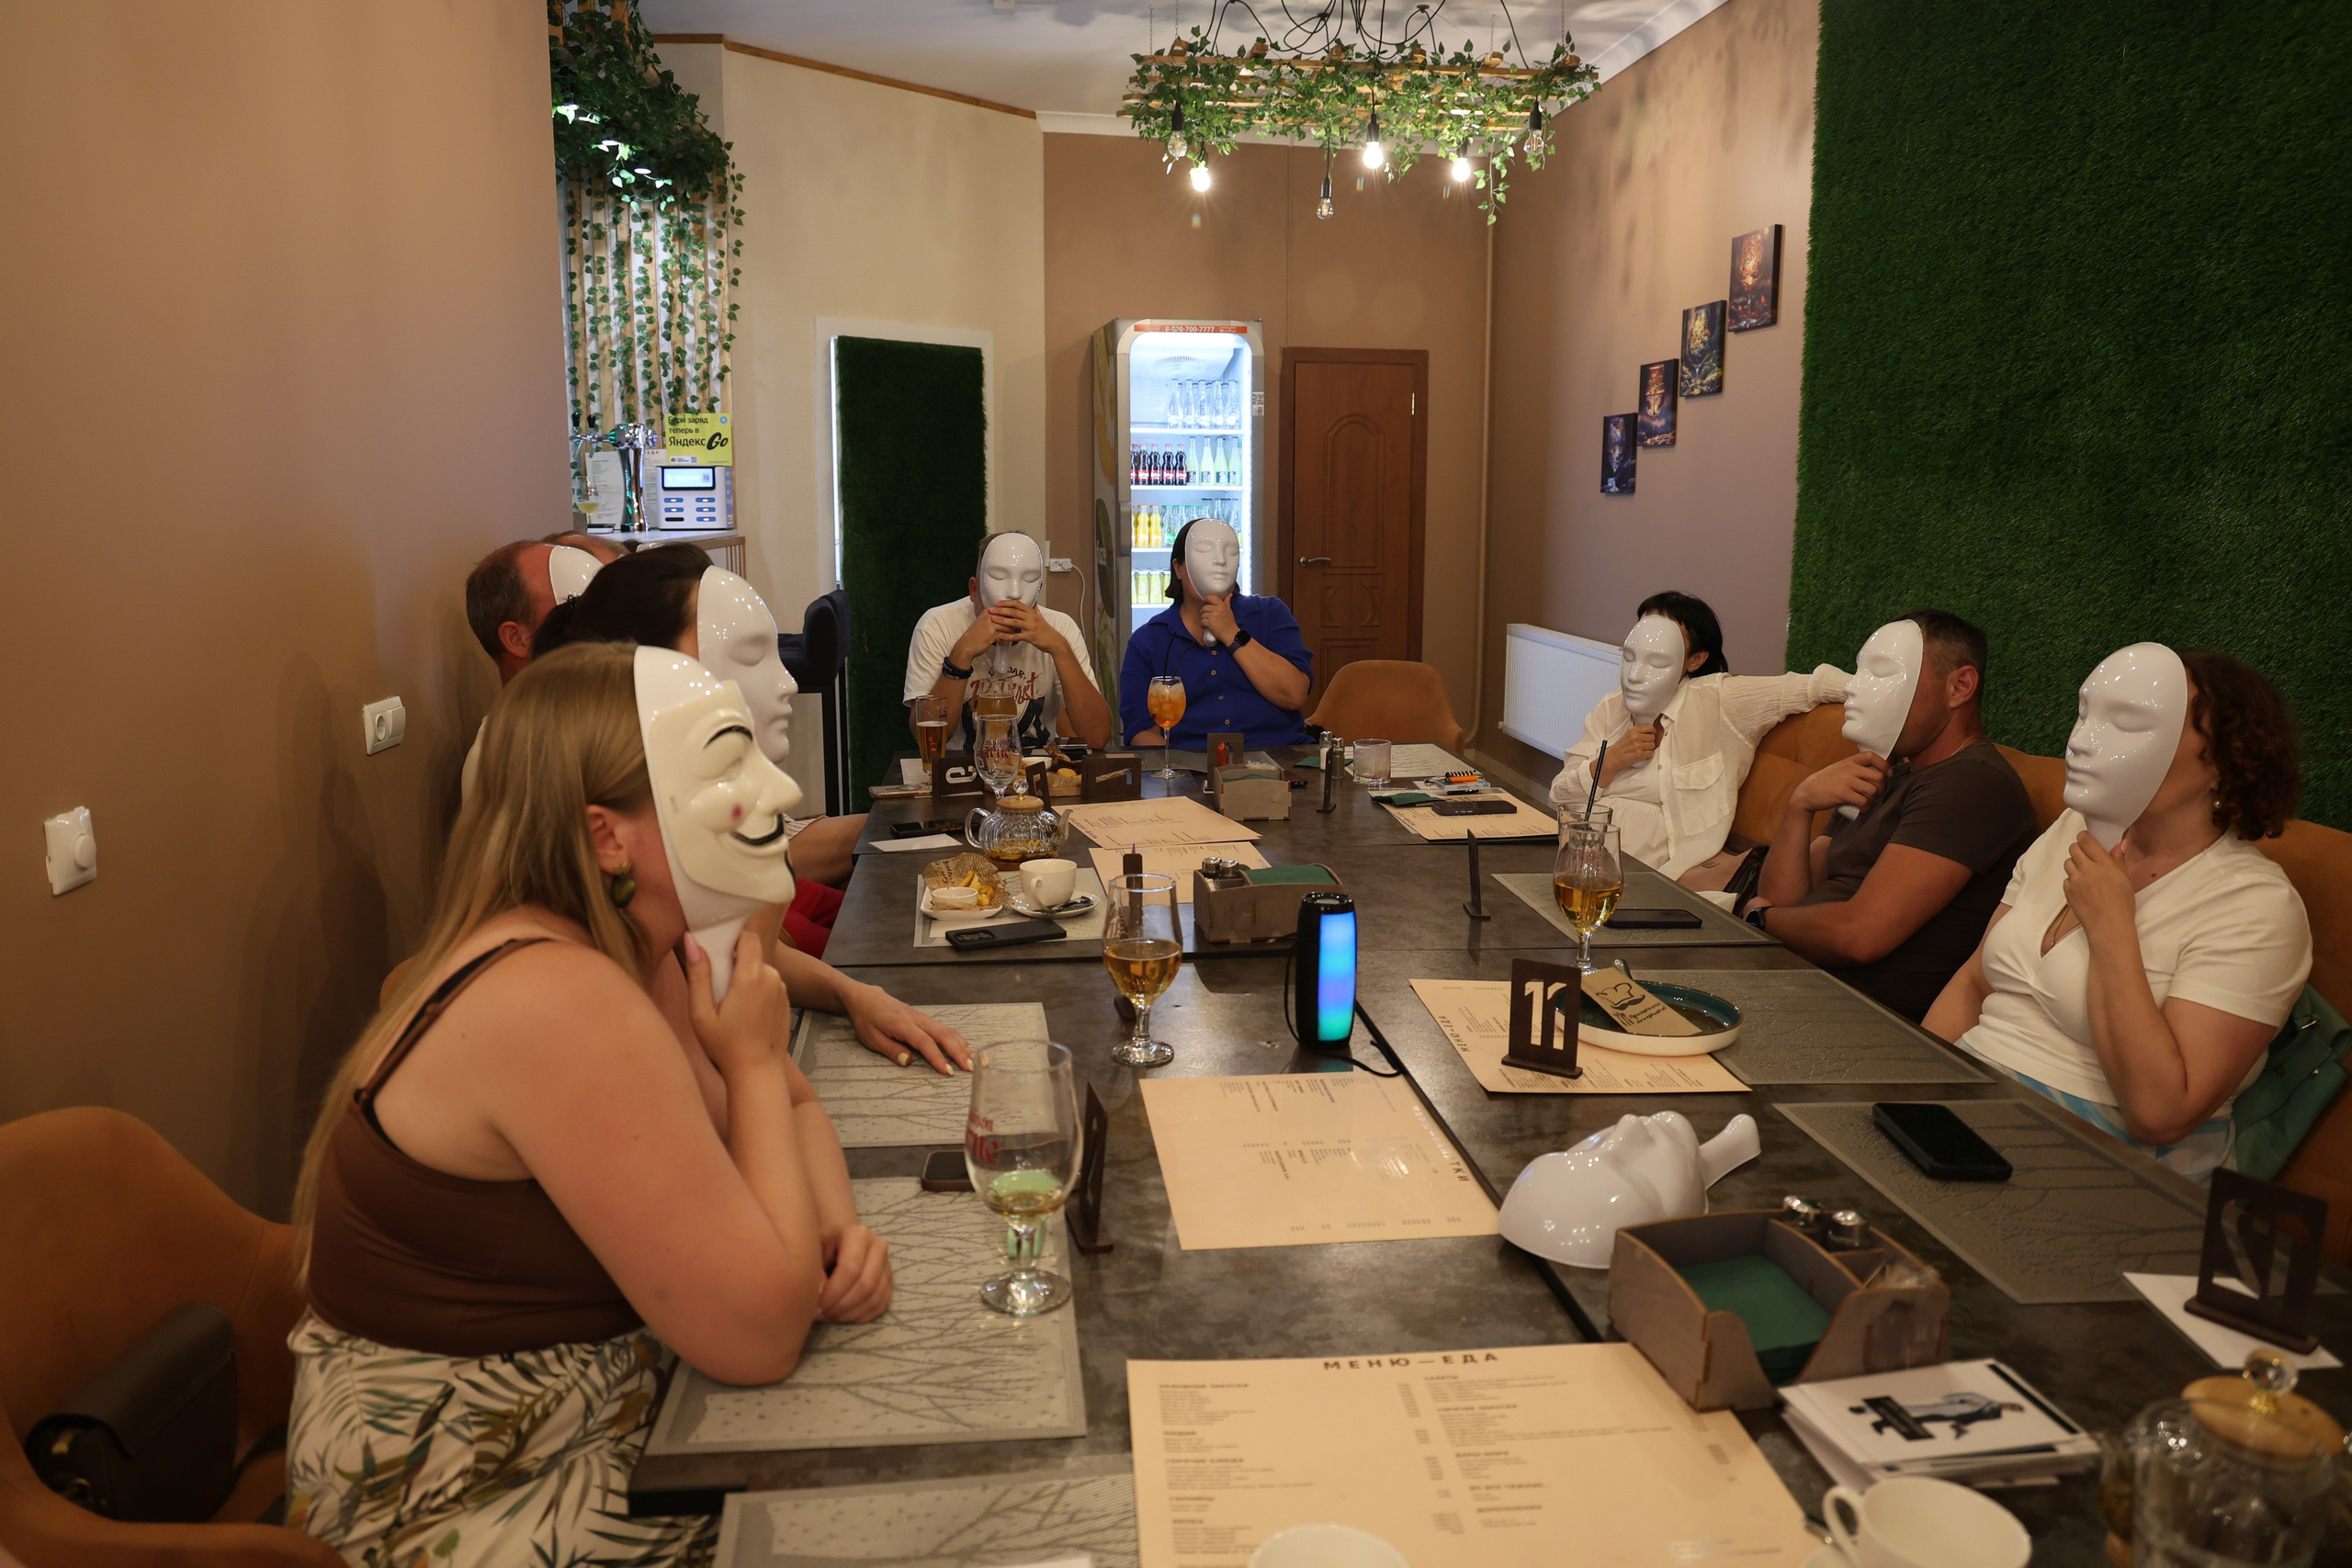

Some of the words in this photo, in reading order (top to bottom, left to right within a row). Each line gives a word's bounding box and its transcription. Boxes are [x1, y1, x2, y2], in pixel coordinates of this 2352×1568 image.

[669, 436, 706, 447] Яндекс
[707, 432, 729, 450] Go
[1323, 1360, 1411, 1371] МЕНЮ
[1442, 1352, 1498, 1364] ЕДА
